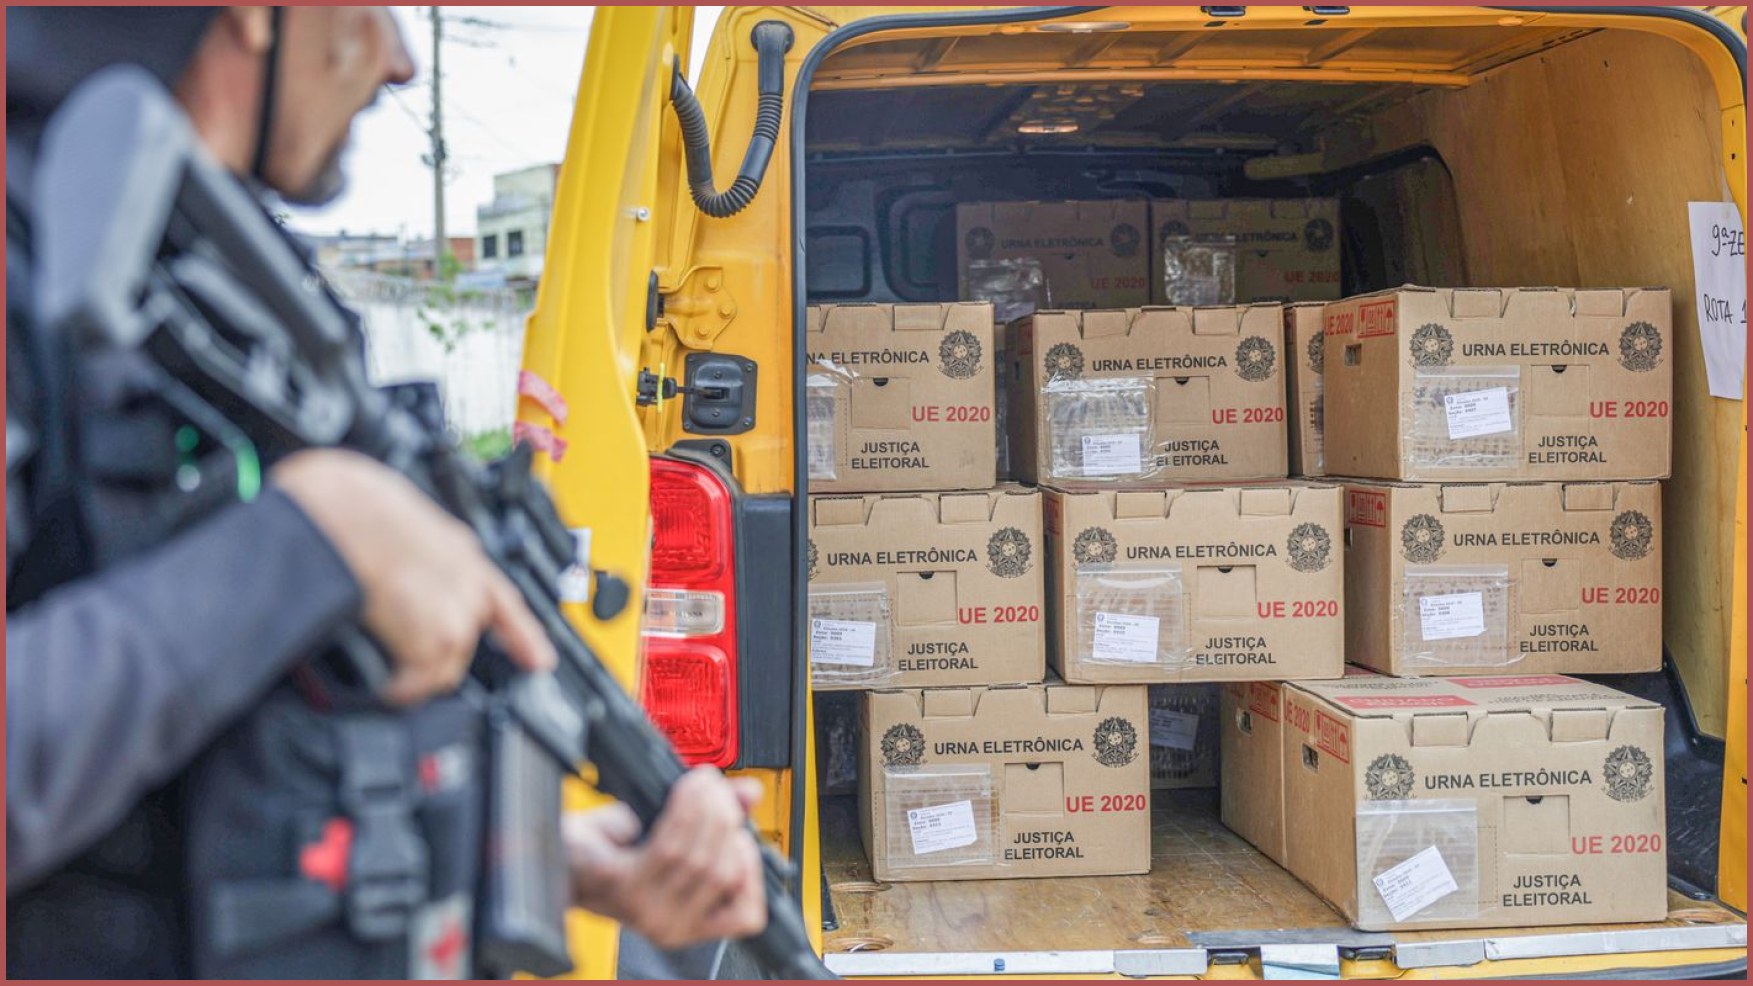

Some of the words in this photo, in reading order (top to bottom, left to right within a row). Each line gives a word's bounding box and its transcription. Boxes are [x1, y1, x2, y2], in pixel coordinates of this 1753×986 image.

[1703, 293, 1733, 325] ROTA
[831, 348, 930, 365] ELETRÔNICA
[1462, 343, 1507, 357] URNA
[1510, 339, 1610, 356] ELETRÔNICA
[1092, 358, 1134, 373] URNA
[1136, 354, 1228, 371] ELETRÔNICA
[911, 404, 942, 424] UE
[946, 404, 991, 423] 2020
[1211, 408, 1237, 427] UE
[1243, 406, 1285, 424] 2020
[1590, 400, 1618, 419] UE
[1624, 399, 1669, 418] 2020
[860, 441, 921, 456] JUSTIÇA
[1164, 439, 1220, 453] JUSTIÇA
[1537, 435, 1598, 450] JUSTIÇA
[851, 456, 930, 470] ELEITORAL
[1528, 451, 1607, 464] ELEITORAL
[1453, 533, 1498, 547] URNA
[1501, 528, 1600, 546] ELETRÔNICA
[827, 551, 873, 566] URNA
[876, 546, 978, 565] ELETRÔNICA
[1126, 546, 1172, 560] URNA
[1175, 541, 1277, 558] ELETRÔNICA
[1581, 586, 1609, 605] UE
[1615, 586, 1660, 605] 2020
[958, 606, 986, 625] UE
[993, 605, 1040, 624] 2020
[1257, 600, 1286, 619] UE
[1291, 599, 1340, 619] 2020
[1529, 624, 1590, 638] JUSTIÇA
[907, 641, 969, 657] JUSTIÇA
[1205, 636, 1267, 651] JUSTIÇA
[1520, 639, 1599, 653] ELEITORAL
[898, 657, 979, 672] ELEITORAL
[1195, 652, 1277, 665] ELEITORAL
[934, 741, 980, 756] URNA
[983, 736, 1084, 754] ELETRÔNICA
[1424, 774, 1475, 790] URNA
[1479, 767, 1593, 788] ELETRÔNICA
[1065, 795, 1095, 813] UE
[1101, 793, 1147, 812] 2020
[1013, 831, 1075, 846] JUSTIÇA
[1571, 835, 1603, 855] UE
[1610, 832, 1663, 854] 2020
[1004, 845, 1084, 861] ELEITORAL
[1513, 874, 1582, 890] JUSTIÇA
[1502, 891, 1593, 907] ELEITORAL
